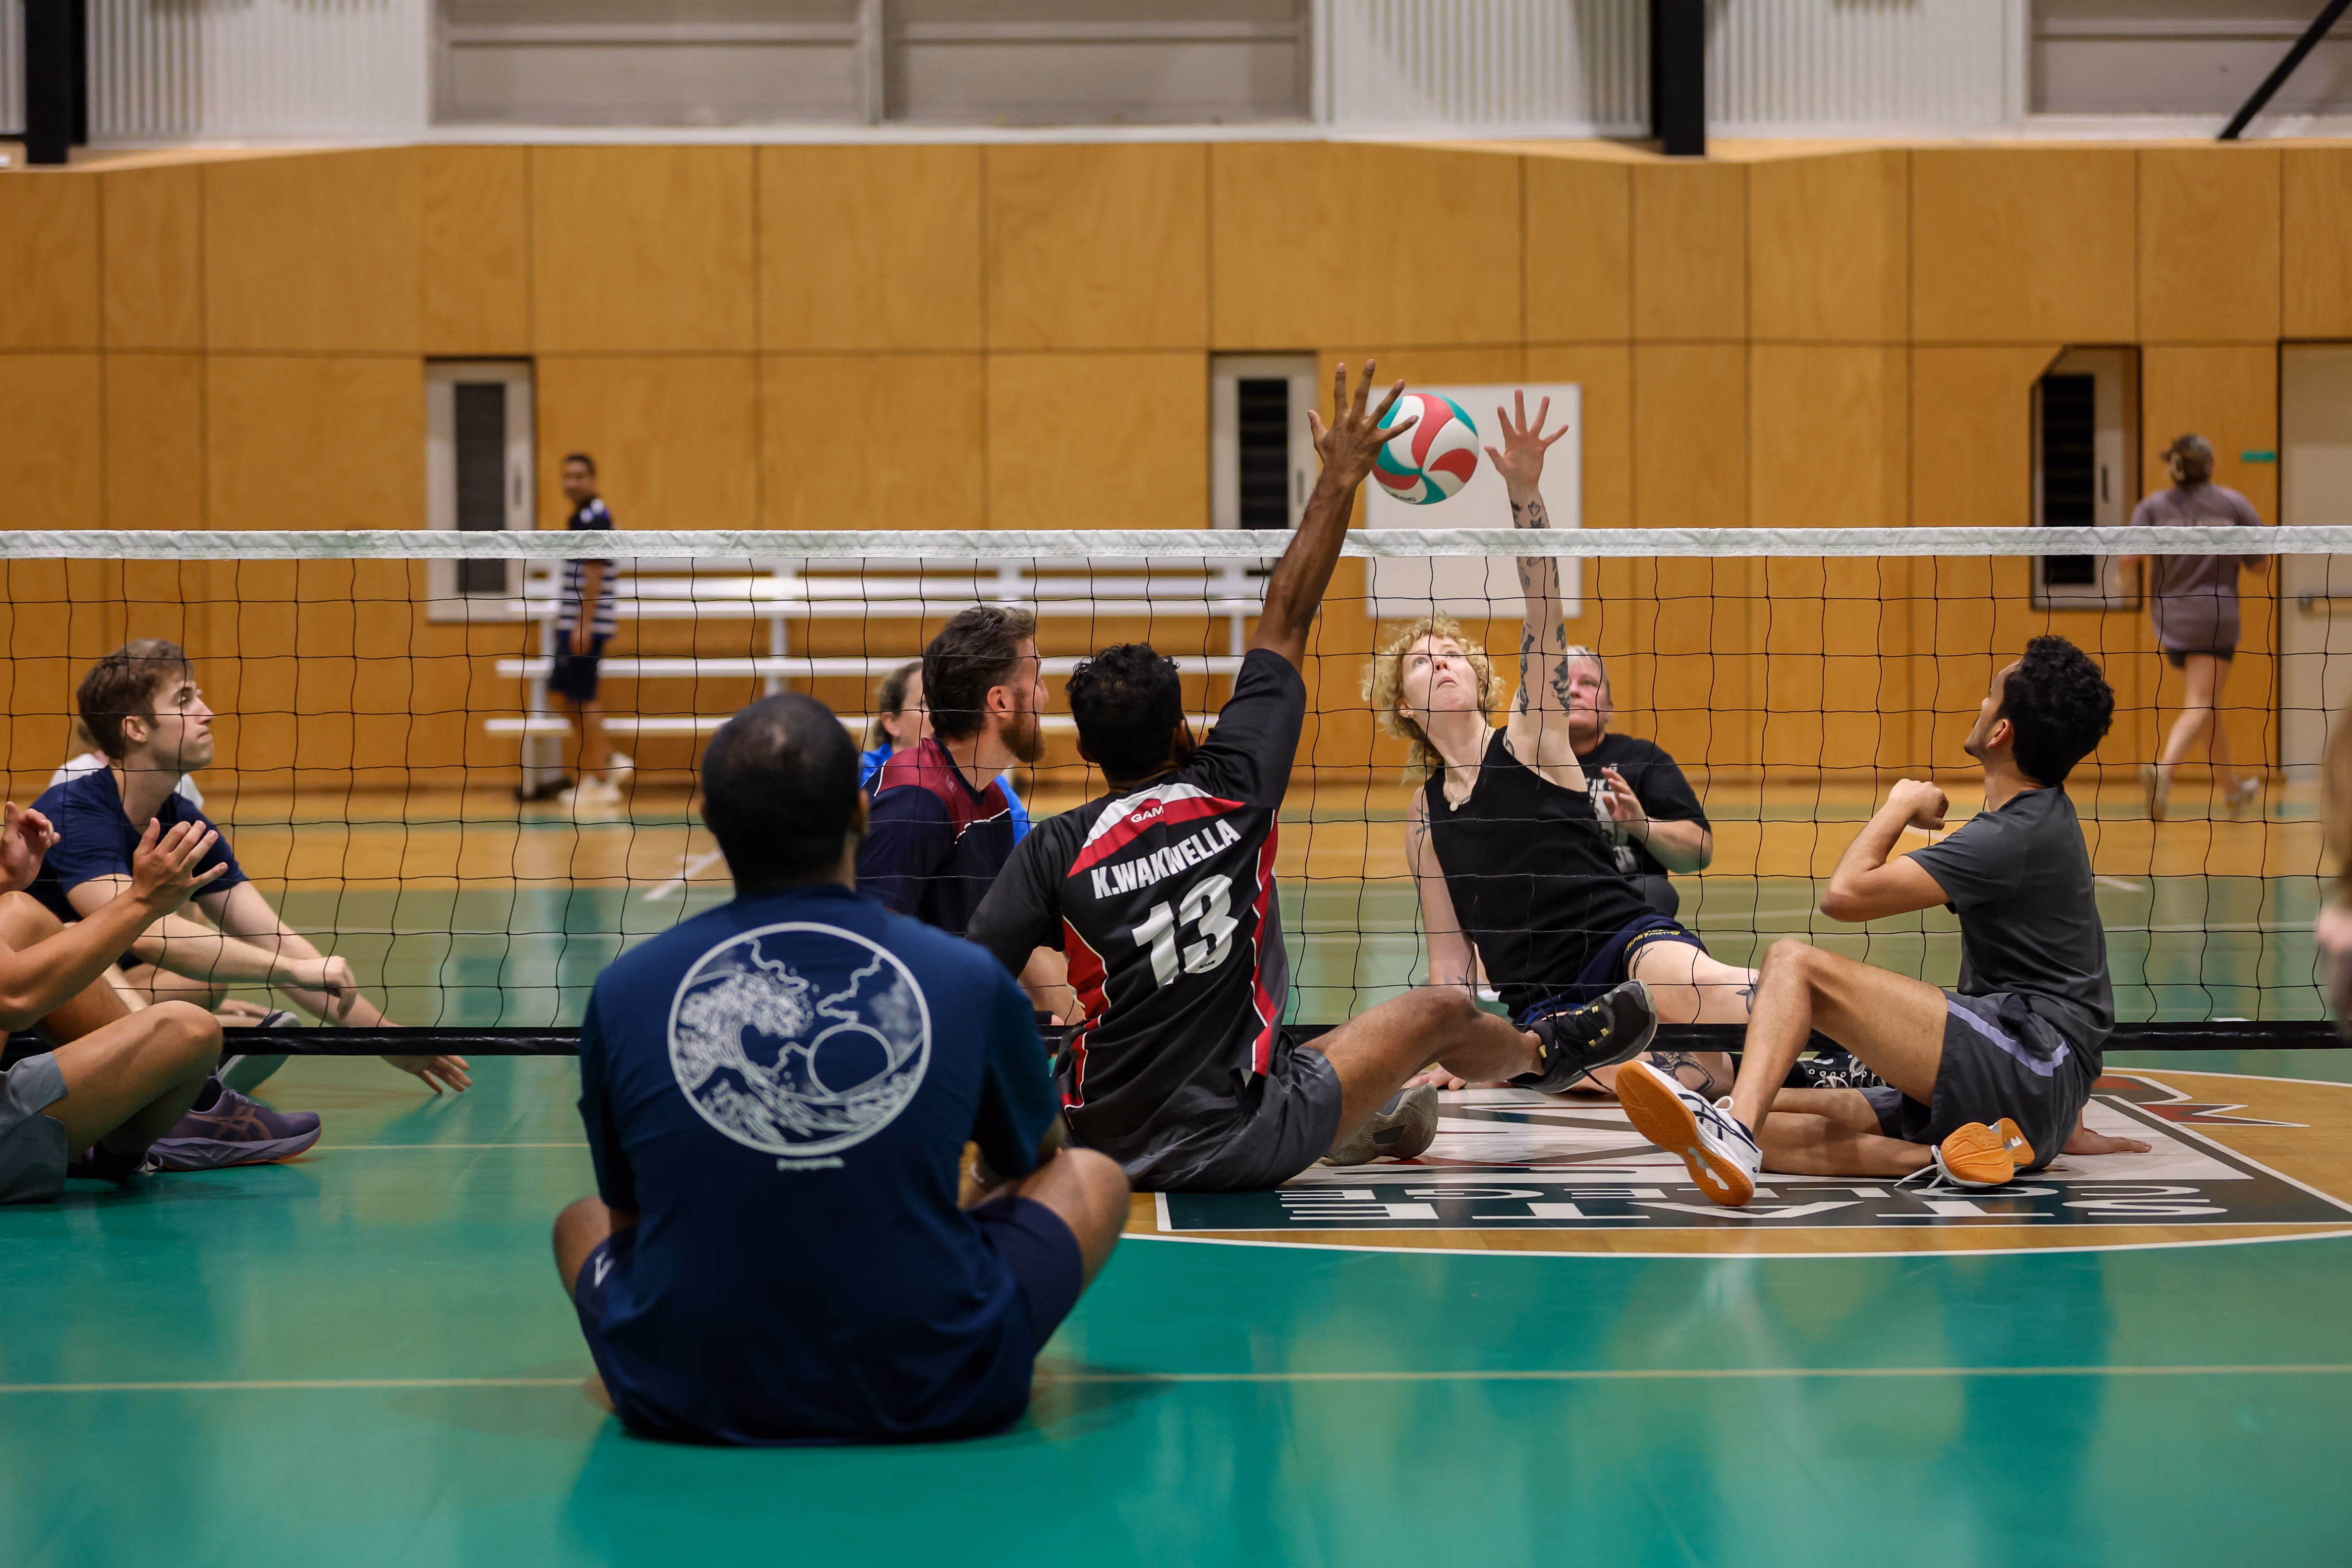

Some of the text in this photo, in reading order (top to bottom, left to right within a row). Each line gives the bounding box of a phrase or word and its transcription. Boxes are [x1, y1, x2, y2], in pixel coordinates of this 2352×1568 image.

[1091, 818, 1241, 899] K.WAKWELLA
[1131, 874, 1239, 990] 13
[1281, 1199, 2229, 1221] STATE
